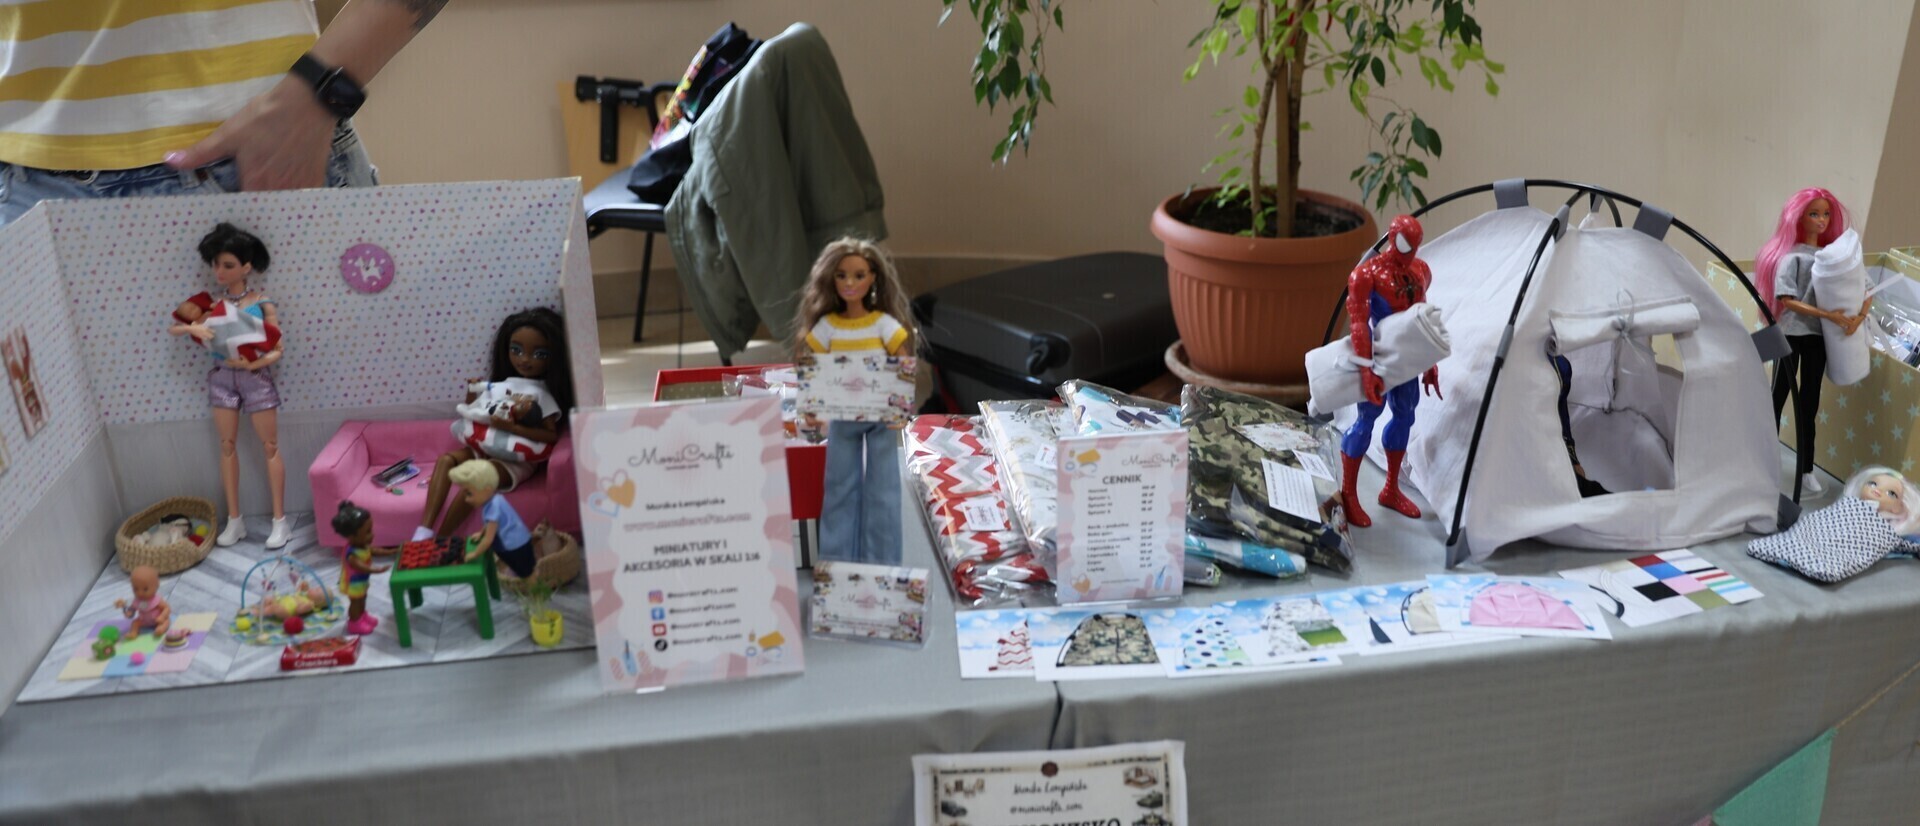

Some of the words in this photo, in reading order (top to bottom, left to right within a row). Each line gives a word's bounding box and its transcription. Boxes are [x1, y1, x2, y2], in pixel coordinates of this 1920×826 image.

[628, 442, 734, 469] MoniCrafts
[1102, 474, 1142, 485] CENNIK
[653, 540, 722, 555] MINIATURY
[623, 557, 691, 573] AKCESORIA
[694, 556, 707, 567] W
[709, 553, 743, 565] SKALI
